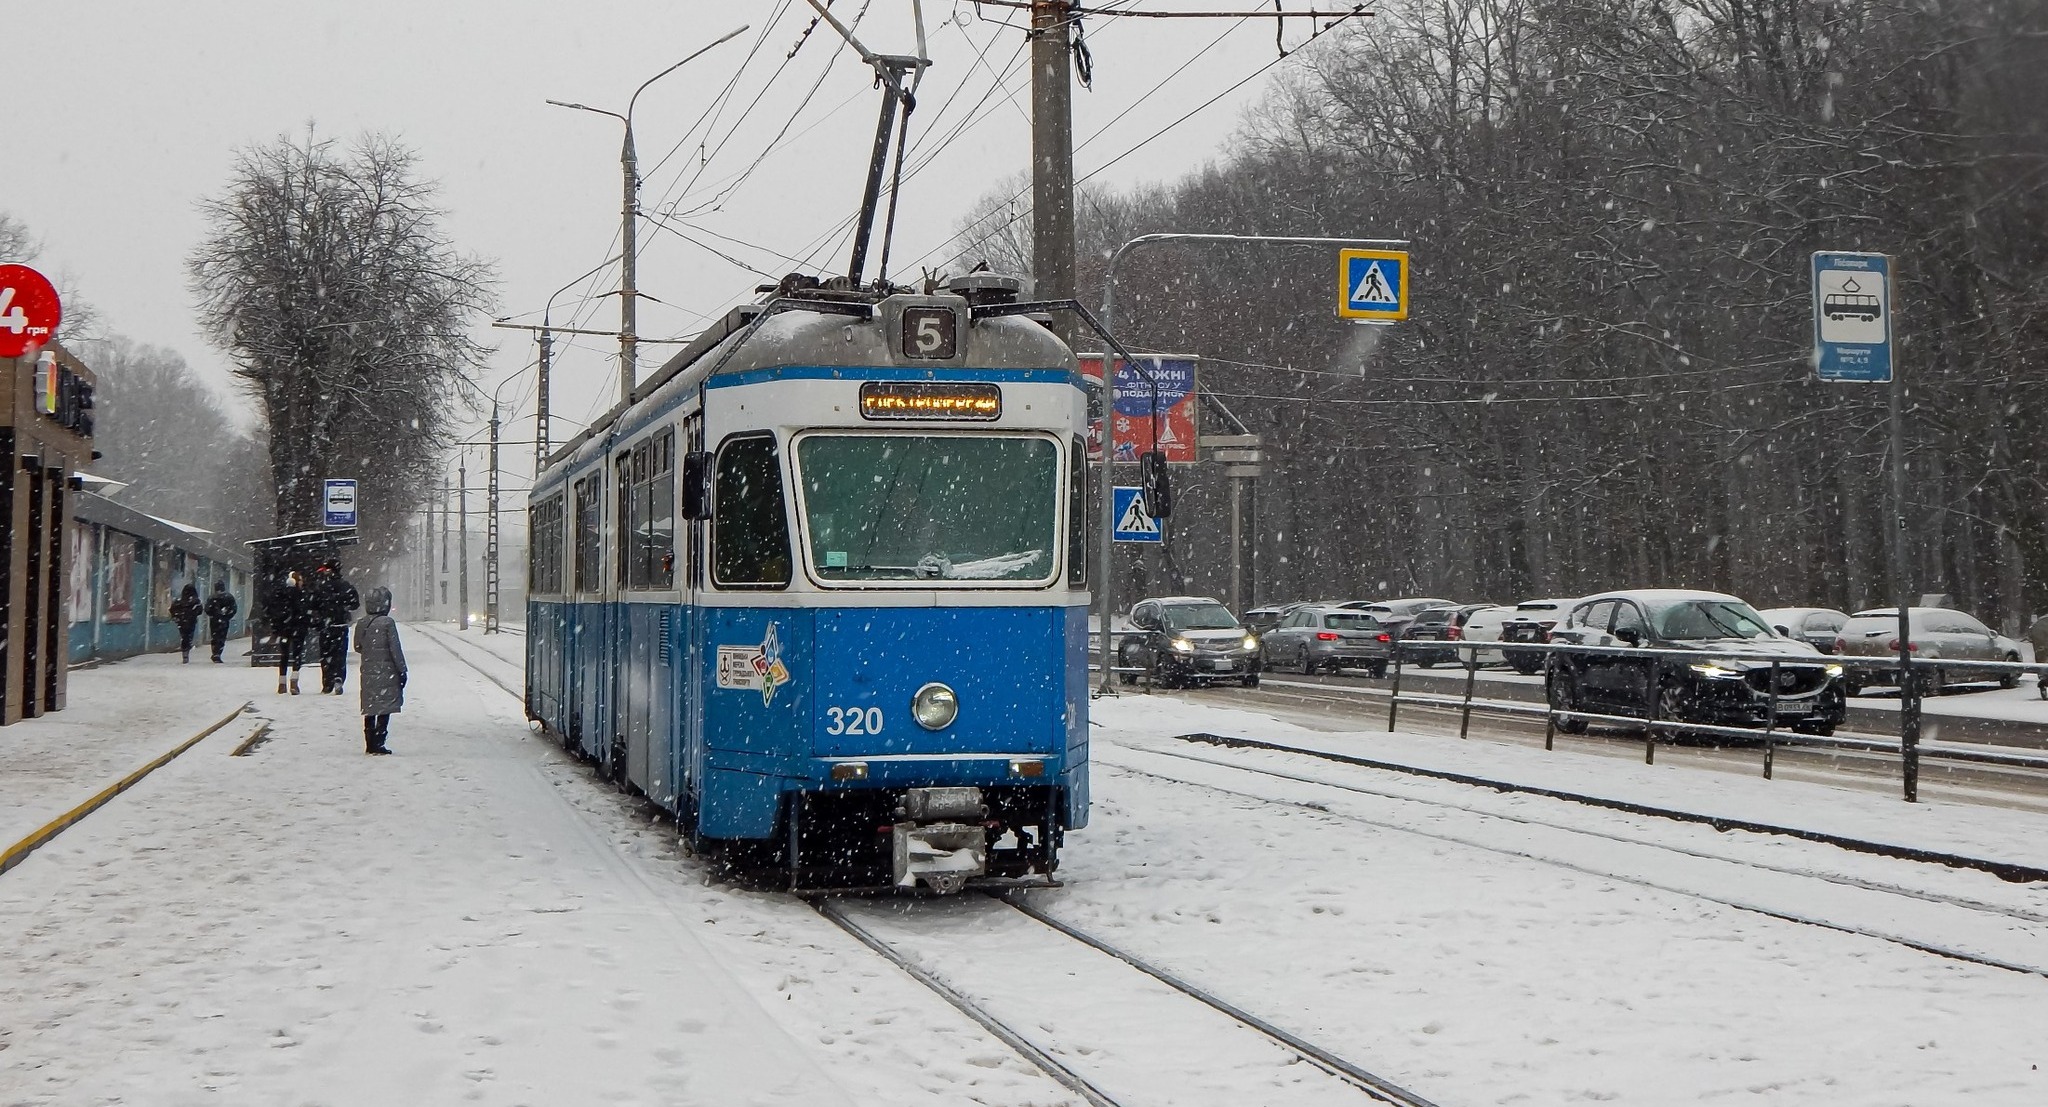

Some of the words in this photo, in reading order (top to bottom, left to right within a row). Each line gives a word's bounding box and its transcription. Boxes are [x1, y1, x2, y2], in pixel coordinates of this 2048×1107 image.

[27, 327, 48, 337] грн
[915, 317, 942, 351] 5
[1122, 390, 1185, 398] ПОДАУНОК
[826, 706, 884, 736] 320
